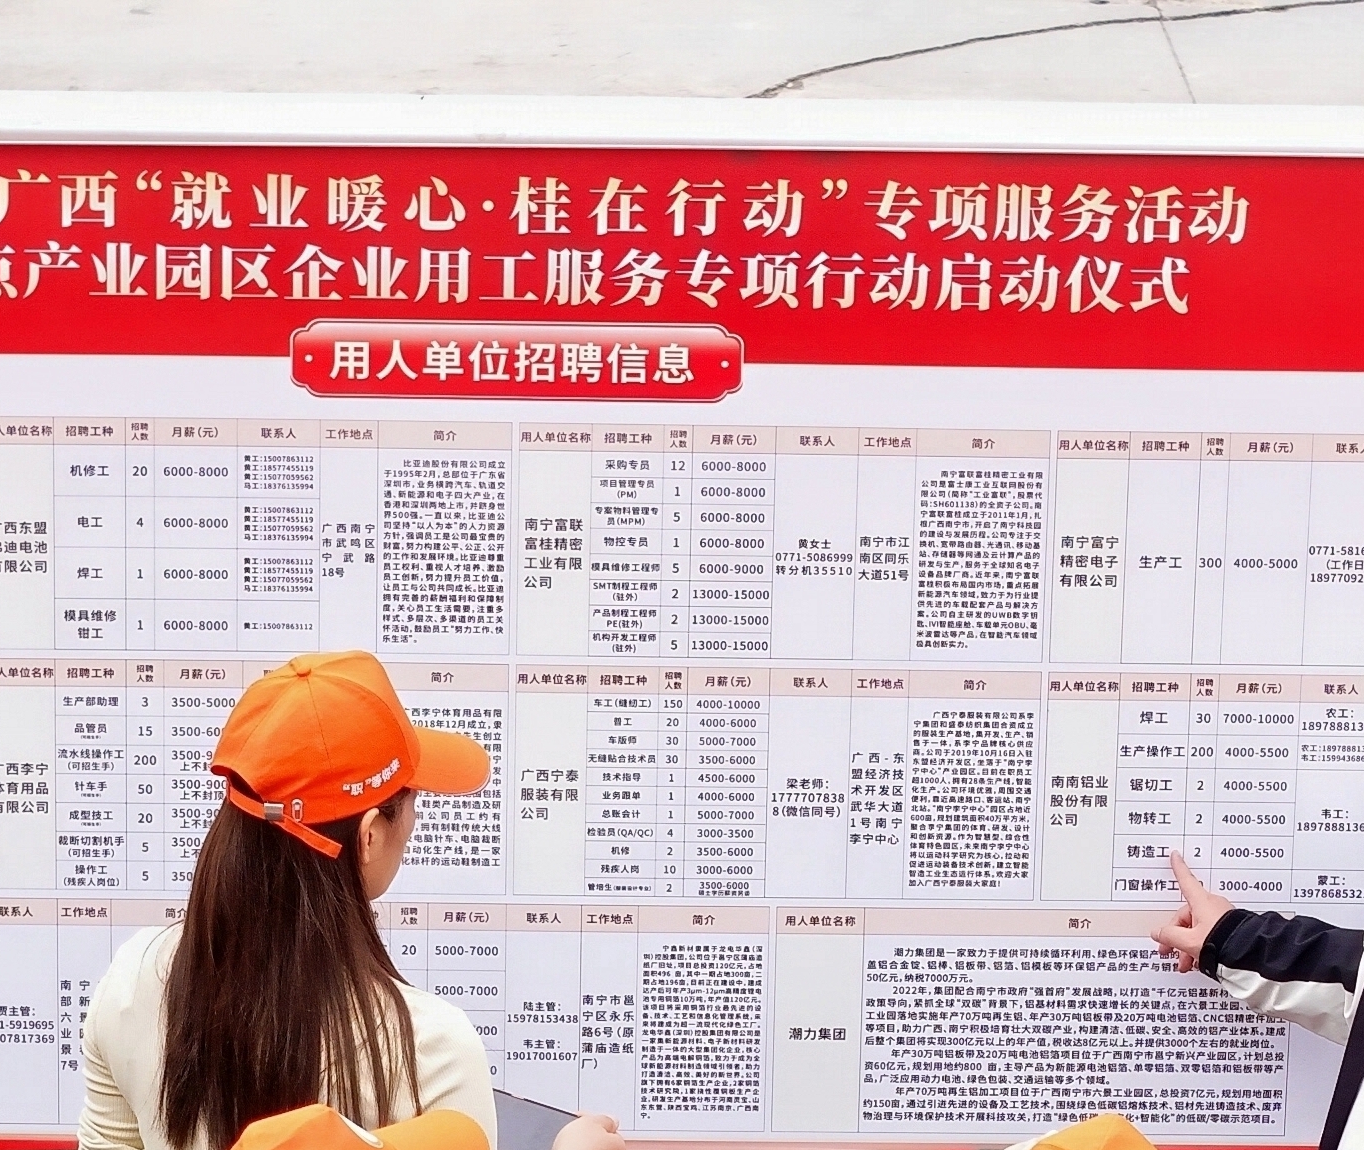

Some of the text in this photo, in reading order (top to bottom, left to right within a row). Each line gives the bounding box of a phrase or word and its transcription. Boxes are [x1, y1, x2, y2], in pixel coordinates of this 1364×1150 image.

[330, 340, 695, 384] 用人单位招聘信息
[70, 465, 109, 476] 机修工
[605, 460, 649, 470] 采购专员
[671, 461, 685, 470] 12
[702, 461, 766, 472] 6000-8000
[133, 466, 147, 476] 20
[164, 467, 228, 477] 6000-8000
[525, 518, 583, 531] 南宁富联
[525, 537, 582, 551] 富桂精密
[799, 539, 831, 549] 黄女士
[860, 536, 909, 547] 南宁市江
[1061, 536, 1119, 549] 南宁富宁
[775, 553, 853, 562] 0771-5086999
[860, 553, 909, 564] 南区同乐
[1060, 555, 1118, 568] 精密电子
[1139, 556, 1182, 569] 生产工
[1199, 558, 1222, 568] 300
[524, 557, 582, 570] 工业有限
[1234, 559, 1298, 569] 4000-5000
[322, 568, 344, 578] 18号
[858, 569, 909, 581] 大道51号
[524, 576, 551, 589] 公司
[1060, 574, 1117, 587] 有限公司
[693, 590, 769, 600] 13000-15000
[64, 610, 116, 622] 模具维修
[78, 627, 103, 639] 钳工
[63, 696, 118, 706] 生产部助理
[171, 697, 236, 709] 3500-5000
[696, 700, 760, 709] 4000-10000
[1140, 711, 1168, 724] 焊工
[1196, 713, 1211, 723] 30
[1223, 714, 1294, 724] 7000-10000
[58, 749, 124, 759] 流水线操作工
[1120, 745, 1185, 757] 生产操作工
[134, 755, 156, 765] 200
[588, 754, 655, 763] 无缝贴合技术员
[521, 769, 578, 782] 广西宁泰
[852, 768, 904, 780] 盟经济技
[1052, 776, 1108, 788] 南南铝业
[1130, 779, 1172, 791] 锯切工
[1224, 781, 1287, 791] 4000-5500
[521, 788, 578, 801] 服装有限
[851, 785, 903, 796] 术开发区
[771, 793, 844, 803] 1777707838
[1050, 795, 1107, 807] 股份有限
[850, 801, 903, 812] 武华大道
[521, 807, 548, 820] 公司
[1128, 812, 1171, 825] 物转工
[1050, 813, 1077, 826] 公司
[59, 836, 124, 846] 裁断切割机手
[850, 833, 899, 845] 李宁中心
[1127, 845, 1170, 858] 铸造工
[1219, 881, 1282, 891] 3000-4000
[1069, 918, 1091, 929] 简介
[435, 946, 498, 956] 5000-7000
[583, 995, 634, 1005] 南宁市邕
[507, 1014, 578, 1023] 15978153438
[789, 1027, 846, 1040] 潮力集团
[582, 1042, 634, 1054] 蒲庙造纸
[507, 1052, 577, 1061] 19017001607
